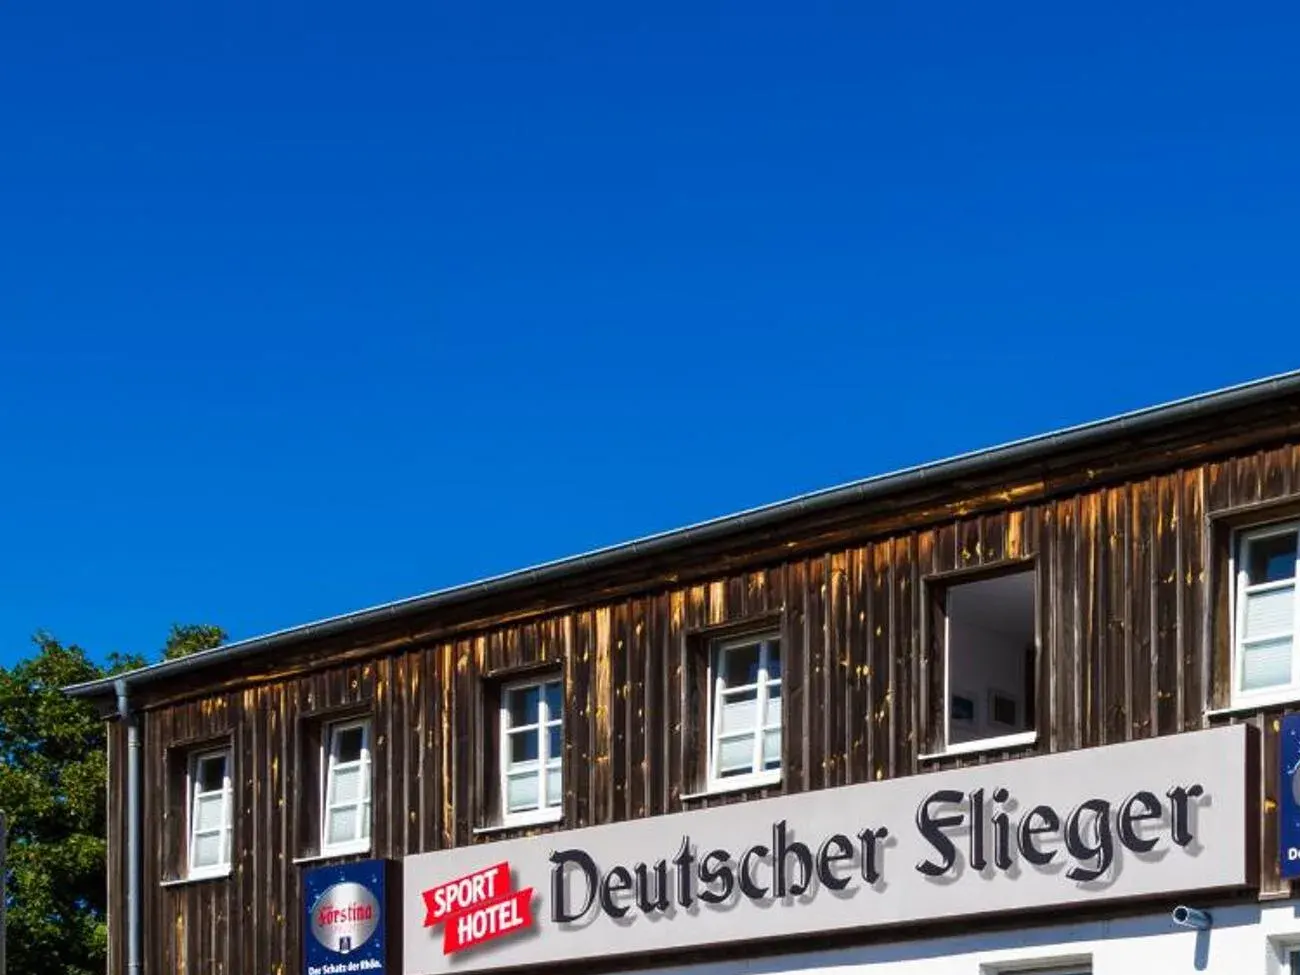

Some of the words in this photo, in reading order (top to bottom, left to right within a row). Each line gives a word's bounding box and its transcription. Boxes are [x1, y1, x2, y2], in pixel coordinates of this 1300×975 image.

[549, 819, 889, 923] Deutscher
[916, 783, 1203, 882] Flieger
[433, 867, 499, 918] SPORT
[457, 898, 524, 945] HOTEL
[347, 961, 360, 972] der
